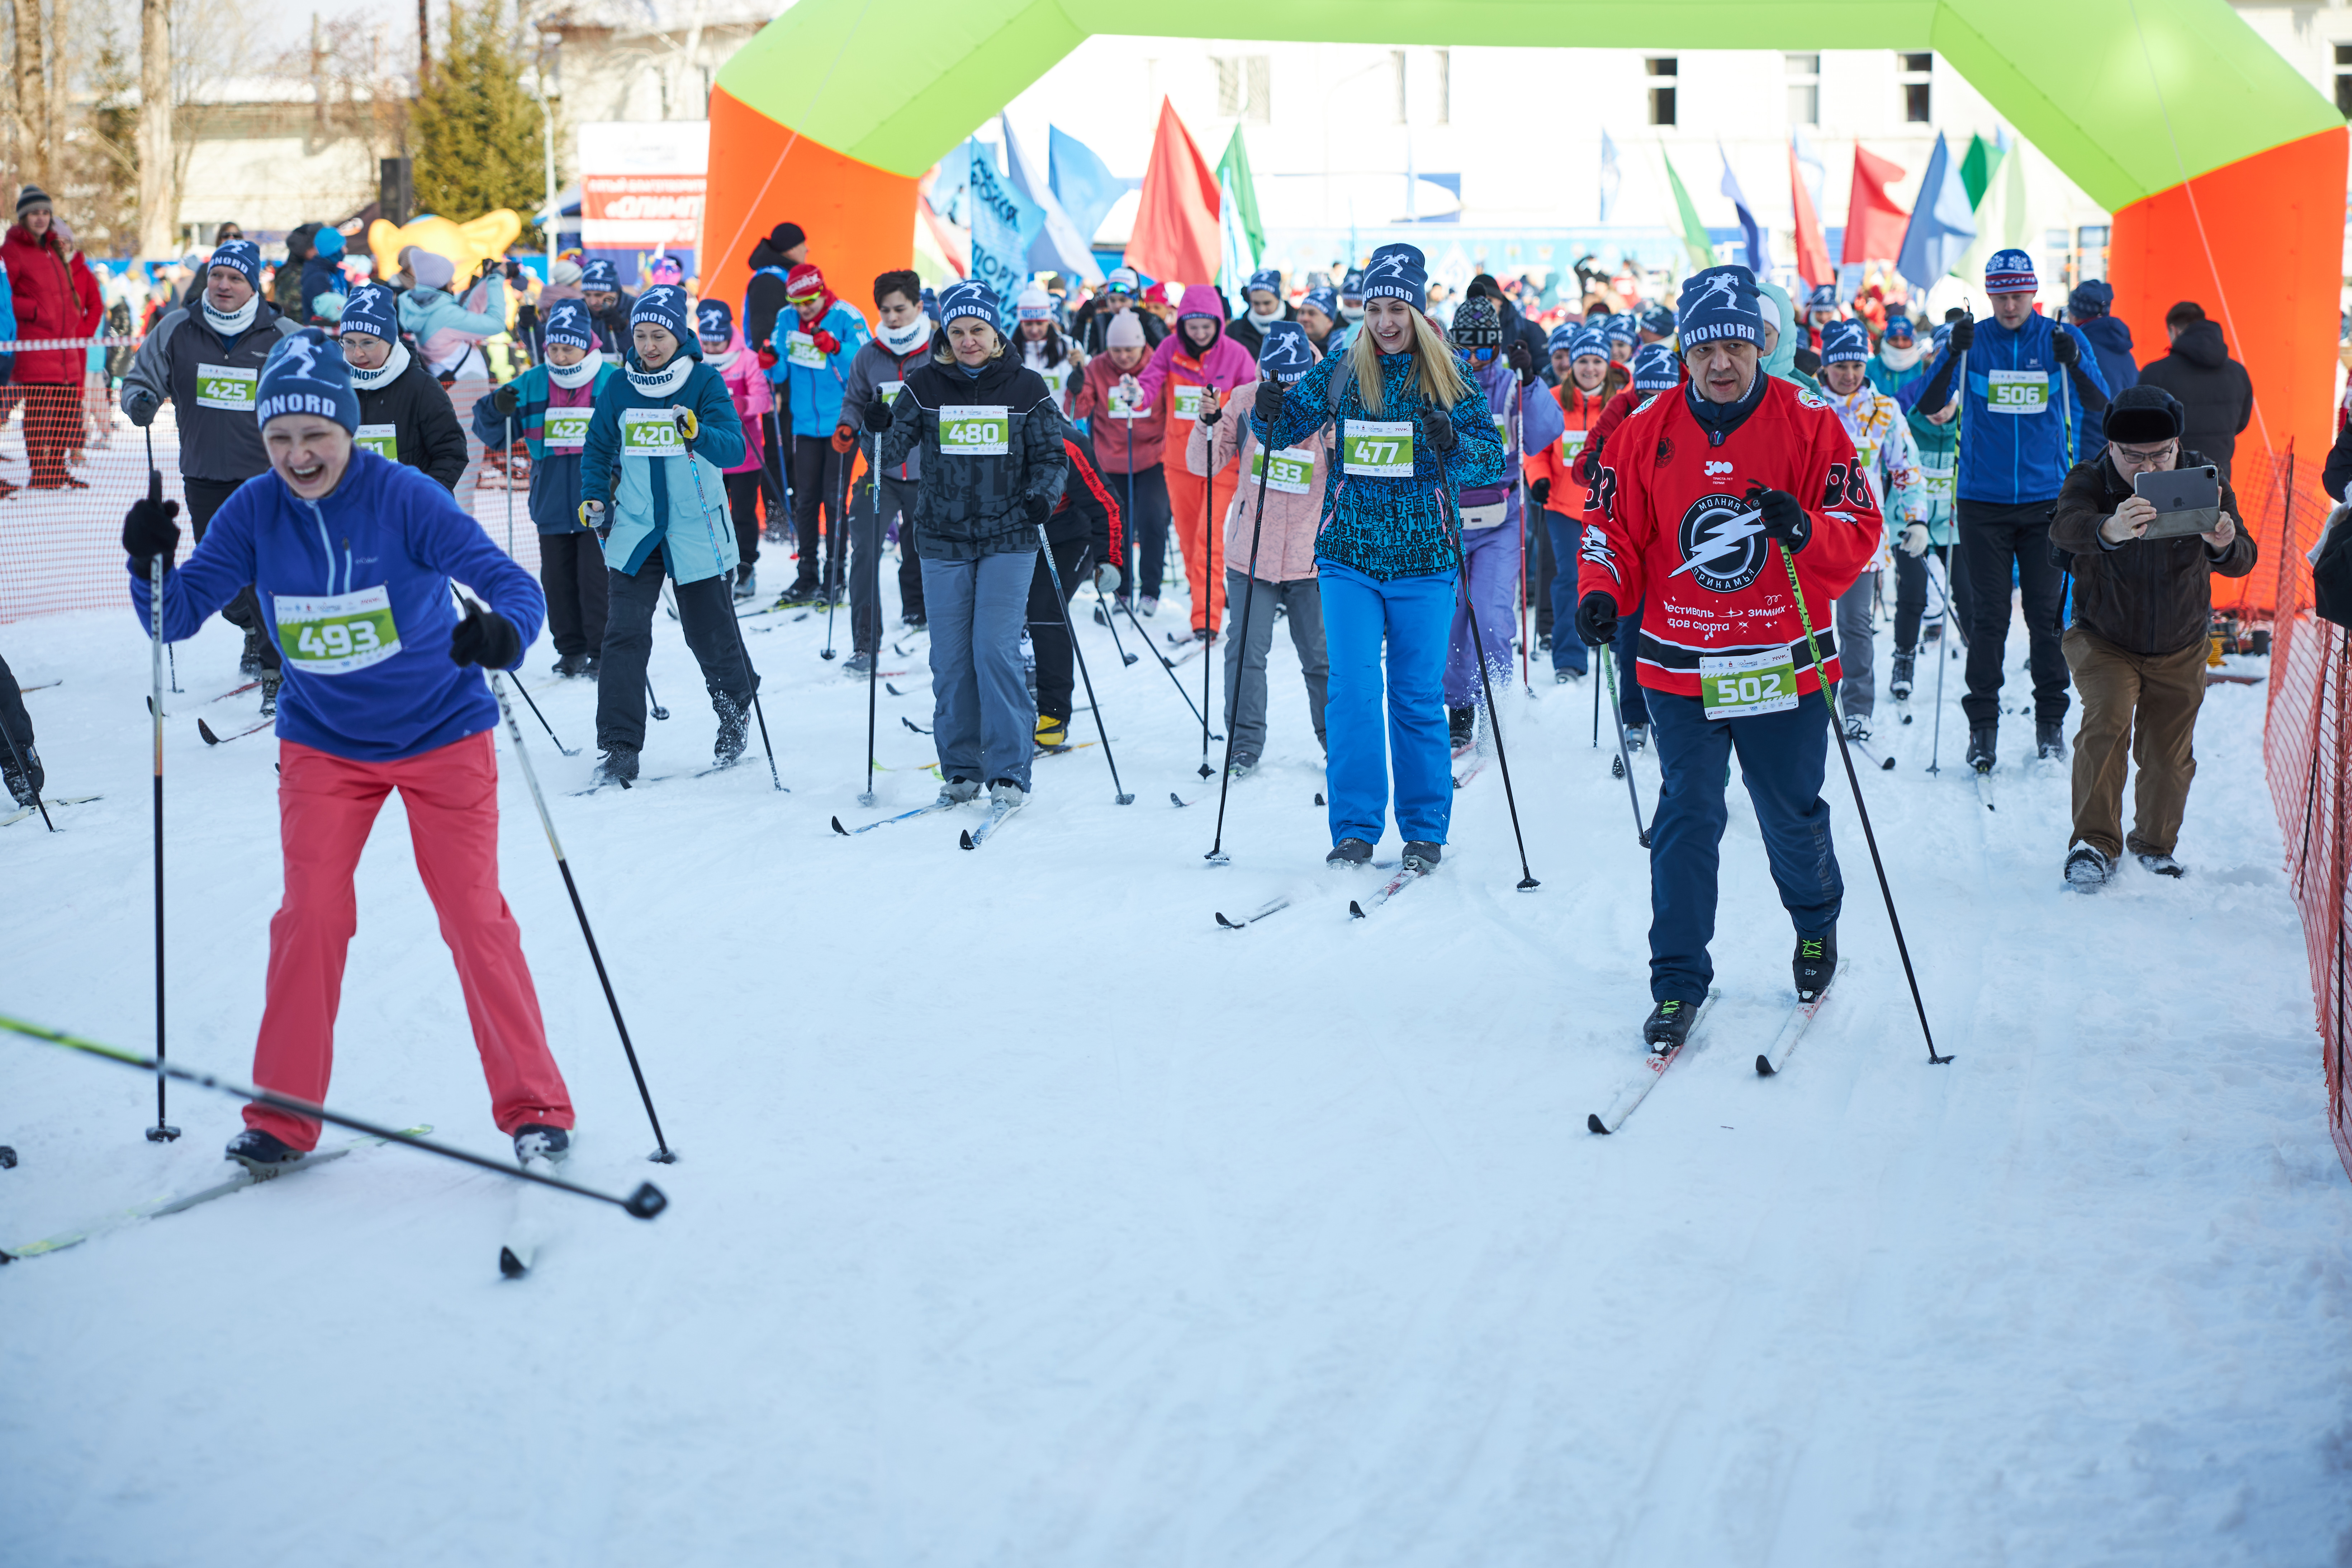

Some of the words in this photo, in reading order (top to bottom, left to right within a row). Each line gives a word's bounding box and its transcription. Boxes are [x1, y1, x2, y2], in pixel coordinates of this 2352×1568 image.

[631, 312, 673, 330] IONORD
[943, 305, 992, 326] BIONORD
[340, 320, 381, 336] IONORD
[1684, 323, 1755, 346] BIONORD
[546, 333, 587, 350] ONORD
[794, 344, 821, 361] 364
[628, 370, 673, 385] BIONORD
[1262, 369, 1307, 382] BINORD
[205, 380, 247, 400] 425
[1996, 386, 2040, 404] 506
[1181, 398, 1200, 413] 37
[1639, 403, 1655, 415] СПОРТА
[552, 421, 587, 437] 422
[633, 426, 675, 445] 420
[949, 423, 999, 443] 480
[1355, 441, 1399, 463] 477
[1704, 461, 1733, 476] 300
[1698, 497, 1741, 511] МОЛНИЯ
[1694, 568, 1755, 589] ПРИКАМЬЯ
[1693, 621, 1730, 636] спорта
[298, 621, 380, 657] 493
[1717, 674, 1782, 703] 502
